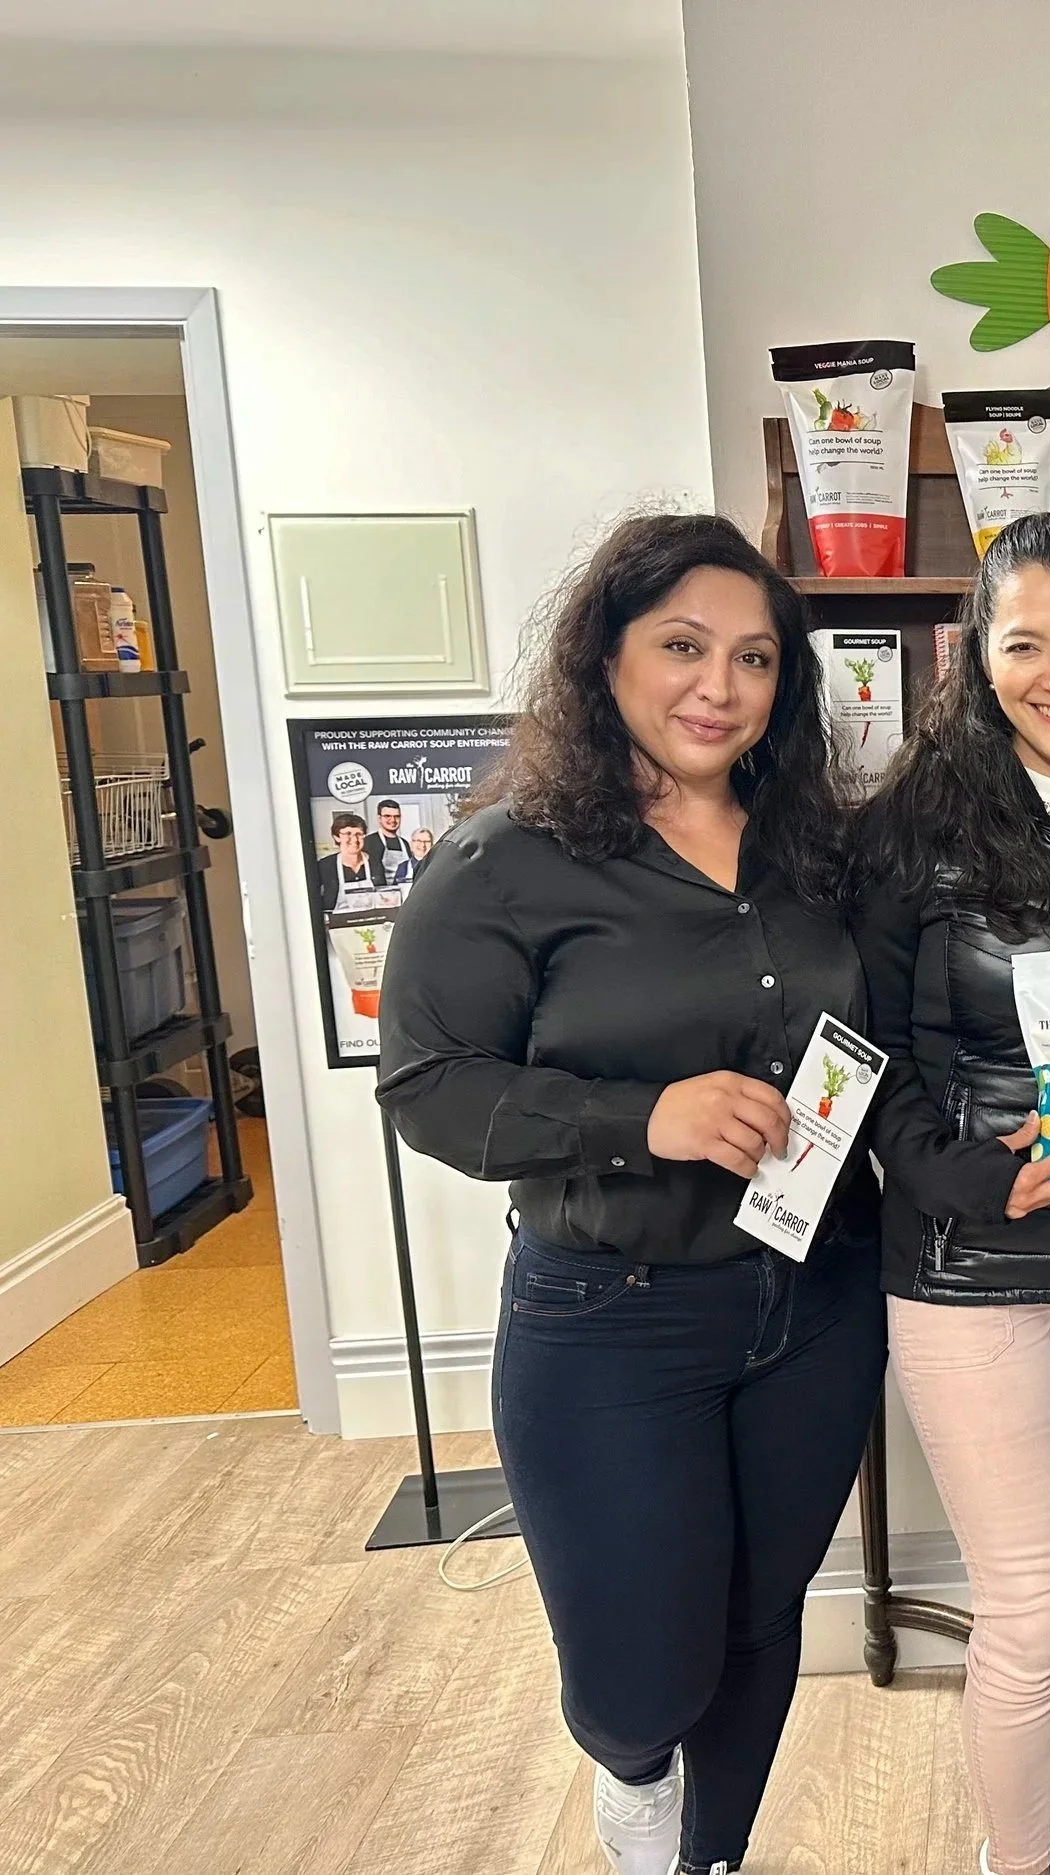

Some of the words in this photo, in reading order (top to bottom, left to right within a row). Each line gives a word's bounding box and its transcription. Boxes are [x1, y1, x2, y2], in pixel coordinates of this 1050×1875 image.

[814, 362, 836, 370] VEGGIE
[836, 359, 857, 367] MANIA
[858, 357, 874, 365] SOUP
[836, 436, 853, 444] bowl
[864, 438, 882, 446] soup
[820, 447, 845, 456] change
[846, 446, 858, 454] the
[818, 492, 842, 502] CARROT
[988, 510, 1007, 519] CARROT
[315, 731, 357, 740] PROUDLY
[360, 729, 418, 738] SUPPORTING
[420, 728, 476, 737] COMMUNITY
[322, 742, 346, 750] WITH
[348, 742, 366, 750] THE
[368, 741, 389, 749] RAW
[391, 740, 428, 749] CARROT
[430, 740, 456, 748] SOUP
[458, 739, 511, 747] ENTERPRISE
[336, 772, 362, 782] MADE
[389, 768, 416, 784] RAW
[424, 767, 472, 783] CARROT
[335, 778, 368, 790] LOCAL
[340, 1039, 364, 1048] FIND
[832, 1031, 859, 1053] GOURMET
[856, 1048, 873, 1063] SOUP
[796, 1107, 806, 1118] Can
[805, 1114, 816, 1124] one
[814, 1118, 826, 1130] bowl
[826, 1125, 832, 1134] of
[831, 1130, 842, 1143] soup
[801, 1122, 818, 1138] change
[817, 1131, 826, 1141] the
[749, 1191, 772, 1215] RAW
[774, 1206, 810, 1237] CARROT
